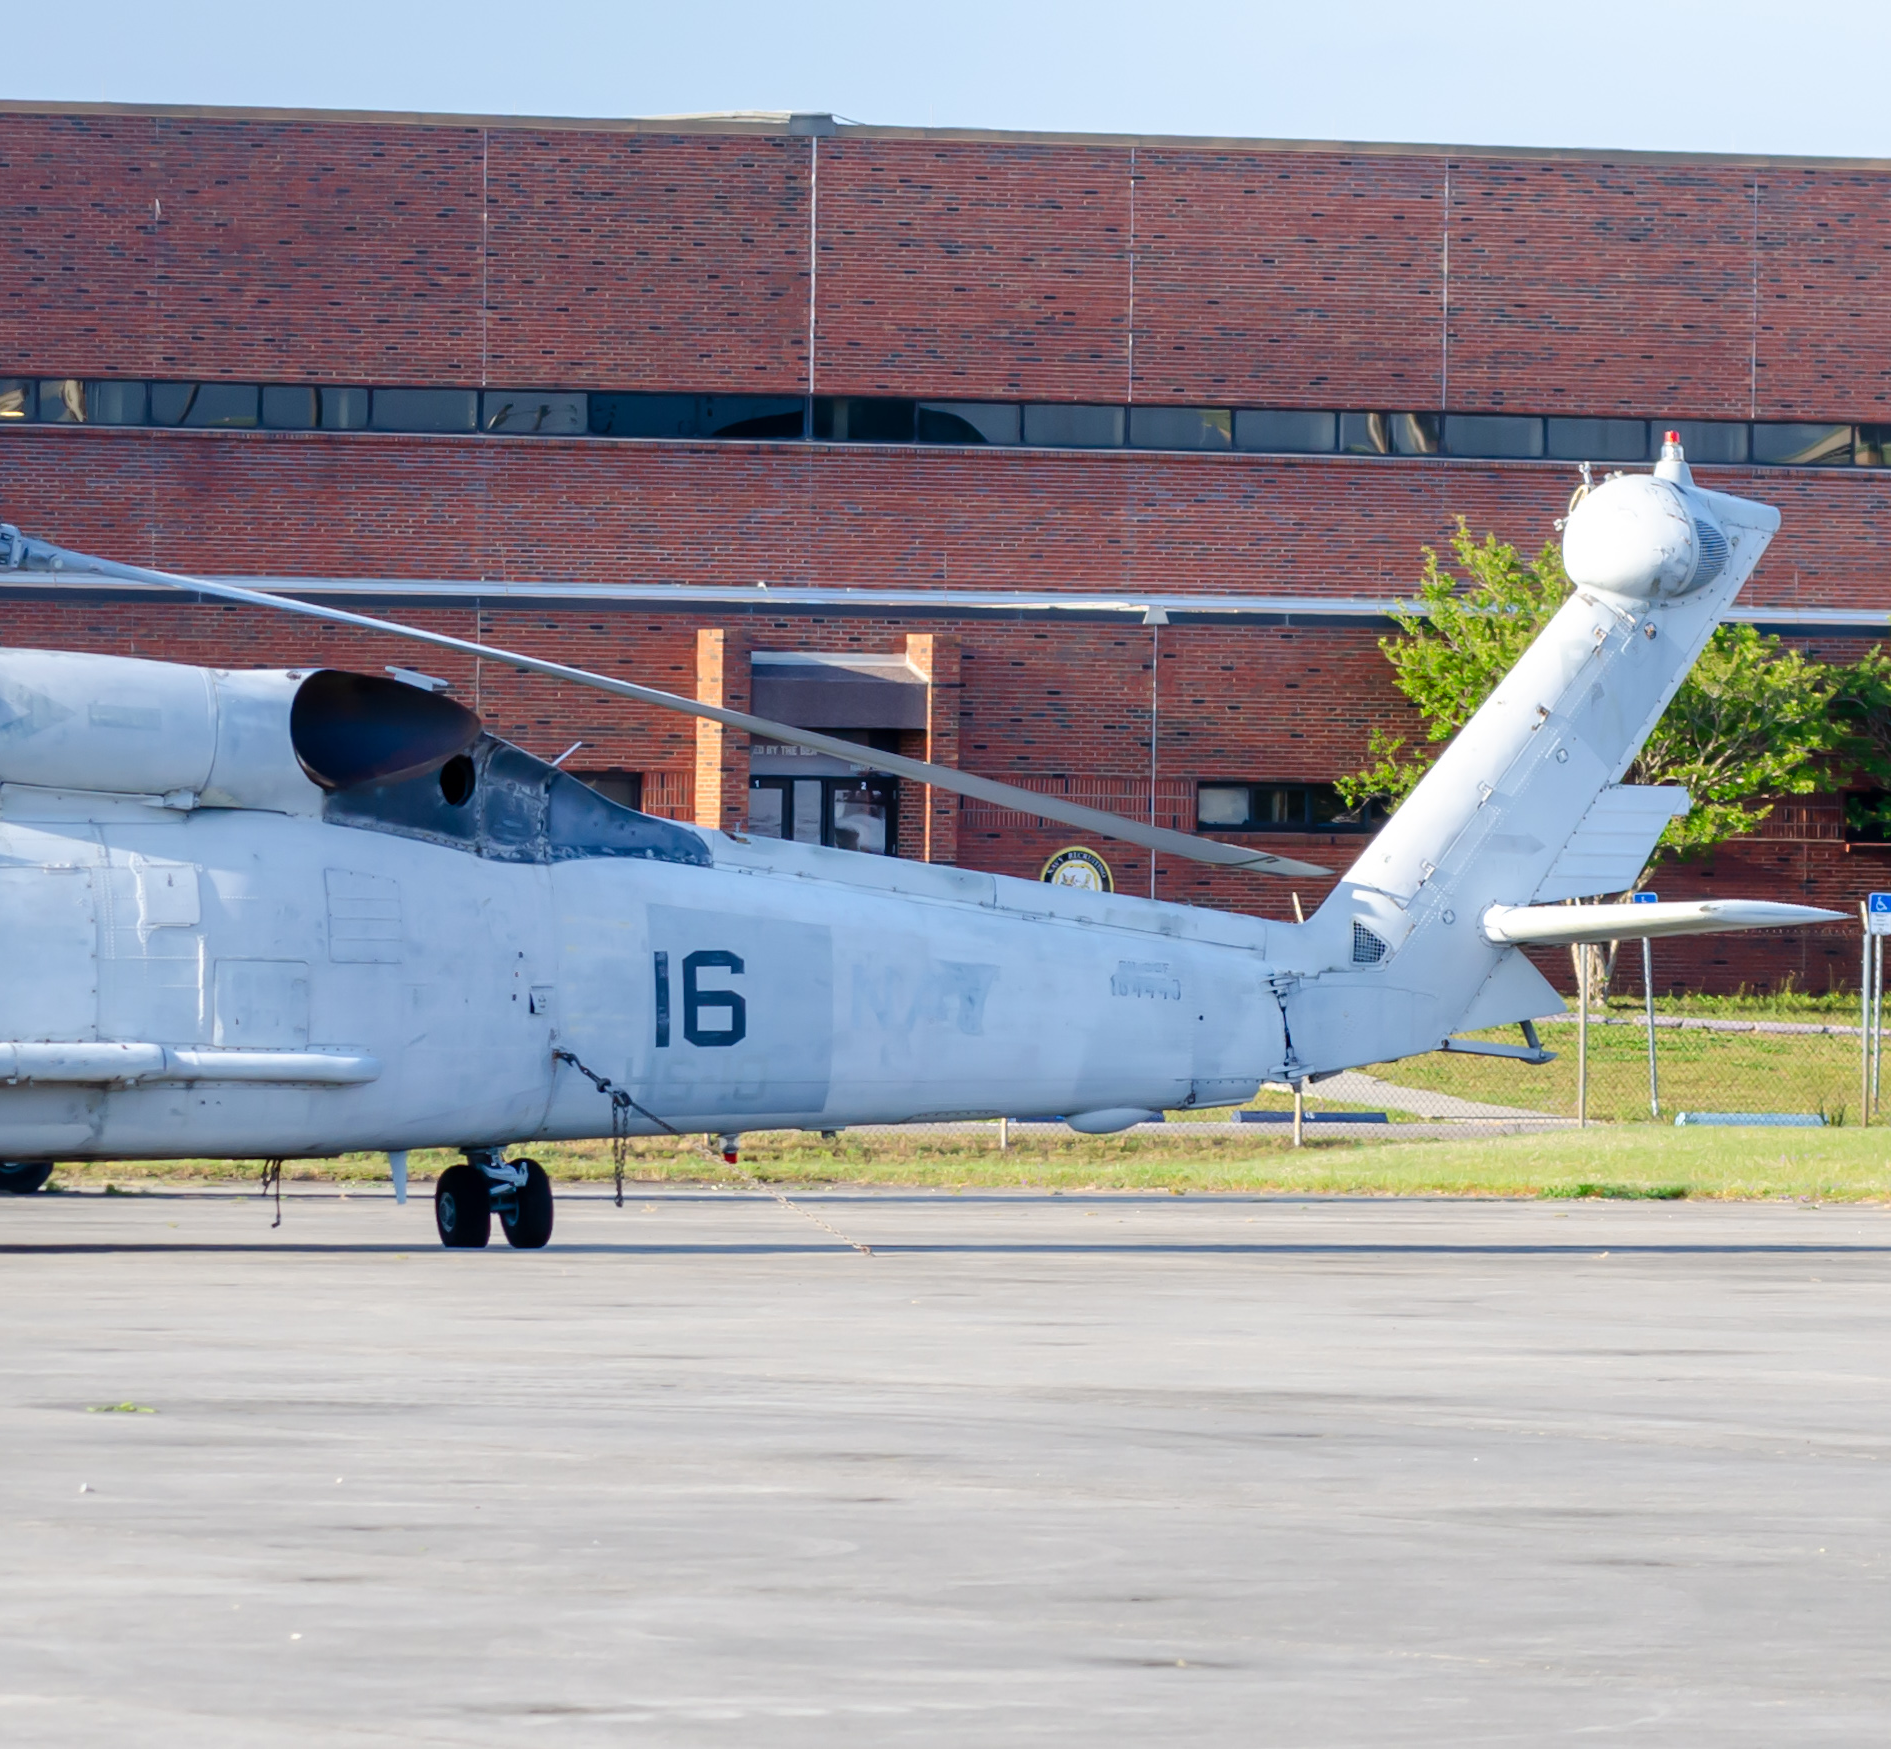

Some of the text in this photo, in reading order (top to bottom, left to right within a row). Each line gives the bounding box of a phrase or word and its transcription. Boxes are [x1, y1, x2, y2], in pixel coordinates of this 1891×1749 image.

[766, 745, 777, 756] BY
[781, 745, 797, 756] THE
[861, 781, 867, 790] 2
[1047, 852, 1107, 879] NAVY RECRUITING
[654, 950, 746, 1047] 16
